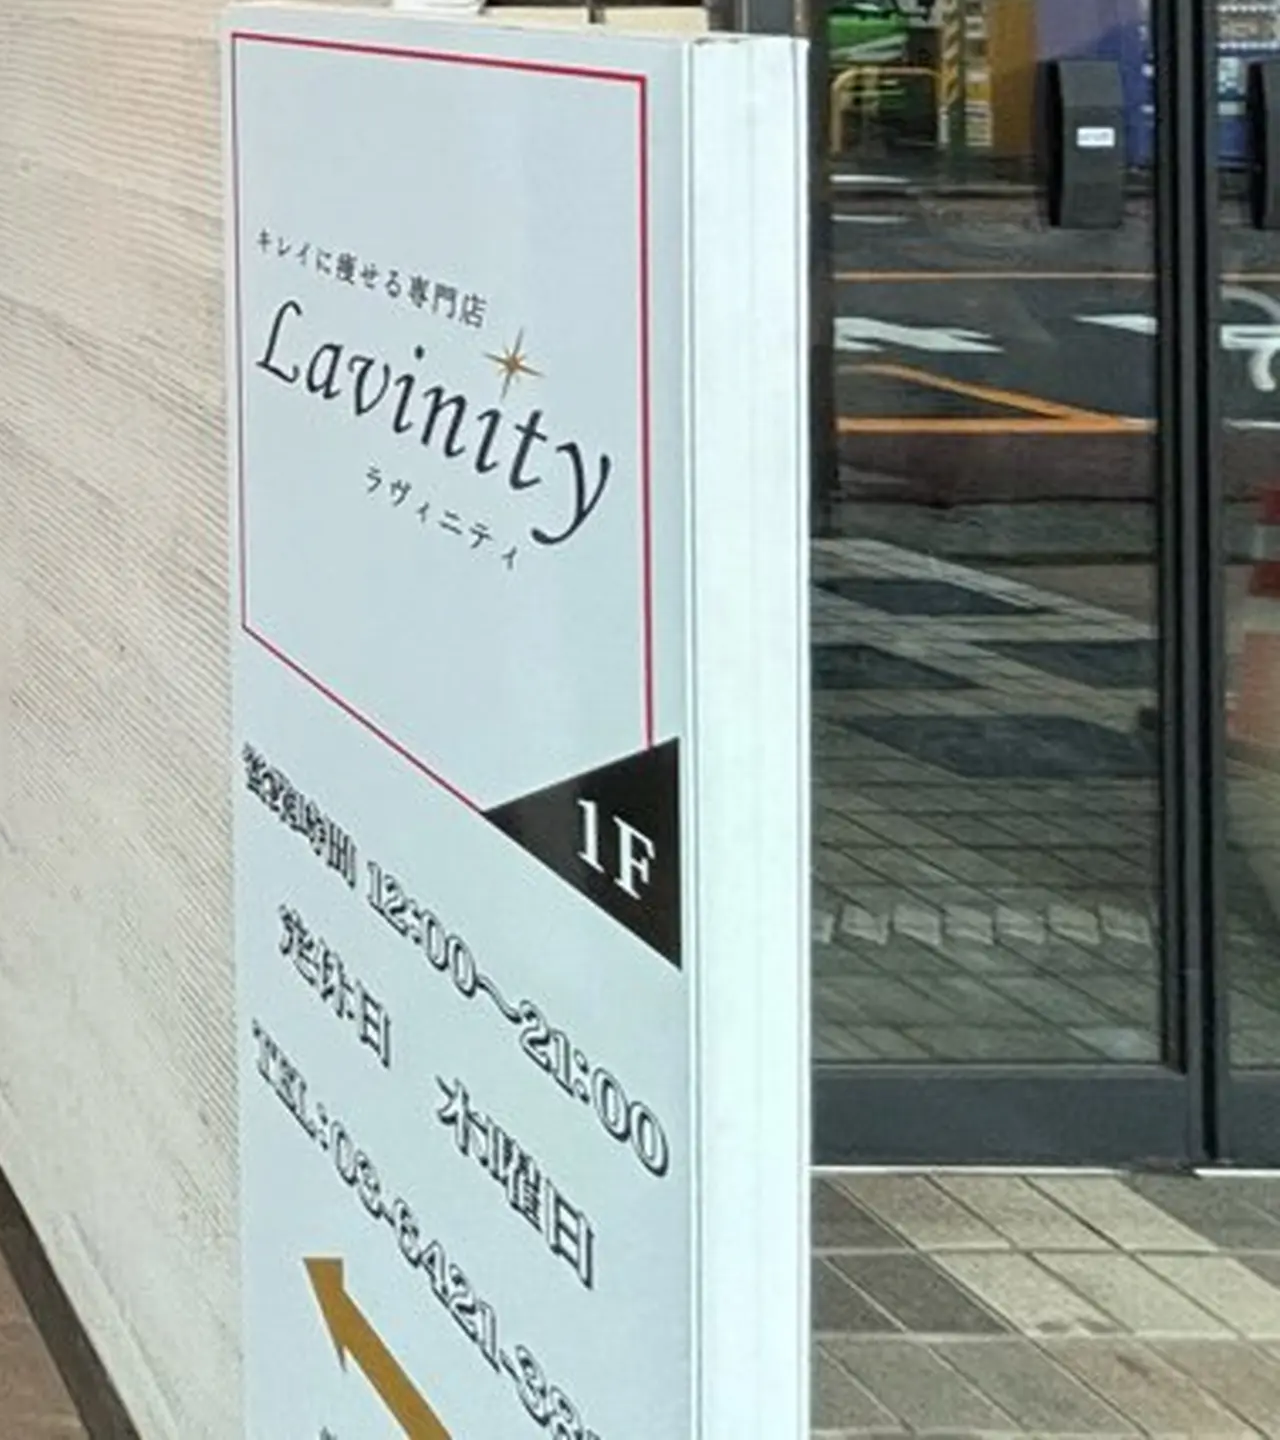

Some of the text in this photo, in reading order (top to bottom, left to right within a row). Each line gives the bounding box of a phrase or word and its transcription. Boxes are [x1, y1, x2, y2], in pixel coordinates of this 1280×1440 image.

[256, 229, 488, 328] キレイに痩せる専門店
[255, 300, 611, 544] Lavinity
[365, 466, 519, 569] ラヴィニティ
[577, 799, 655, 900] 1F
[277, 903, 595, 1291] 定休日 木曜日
